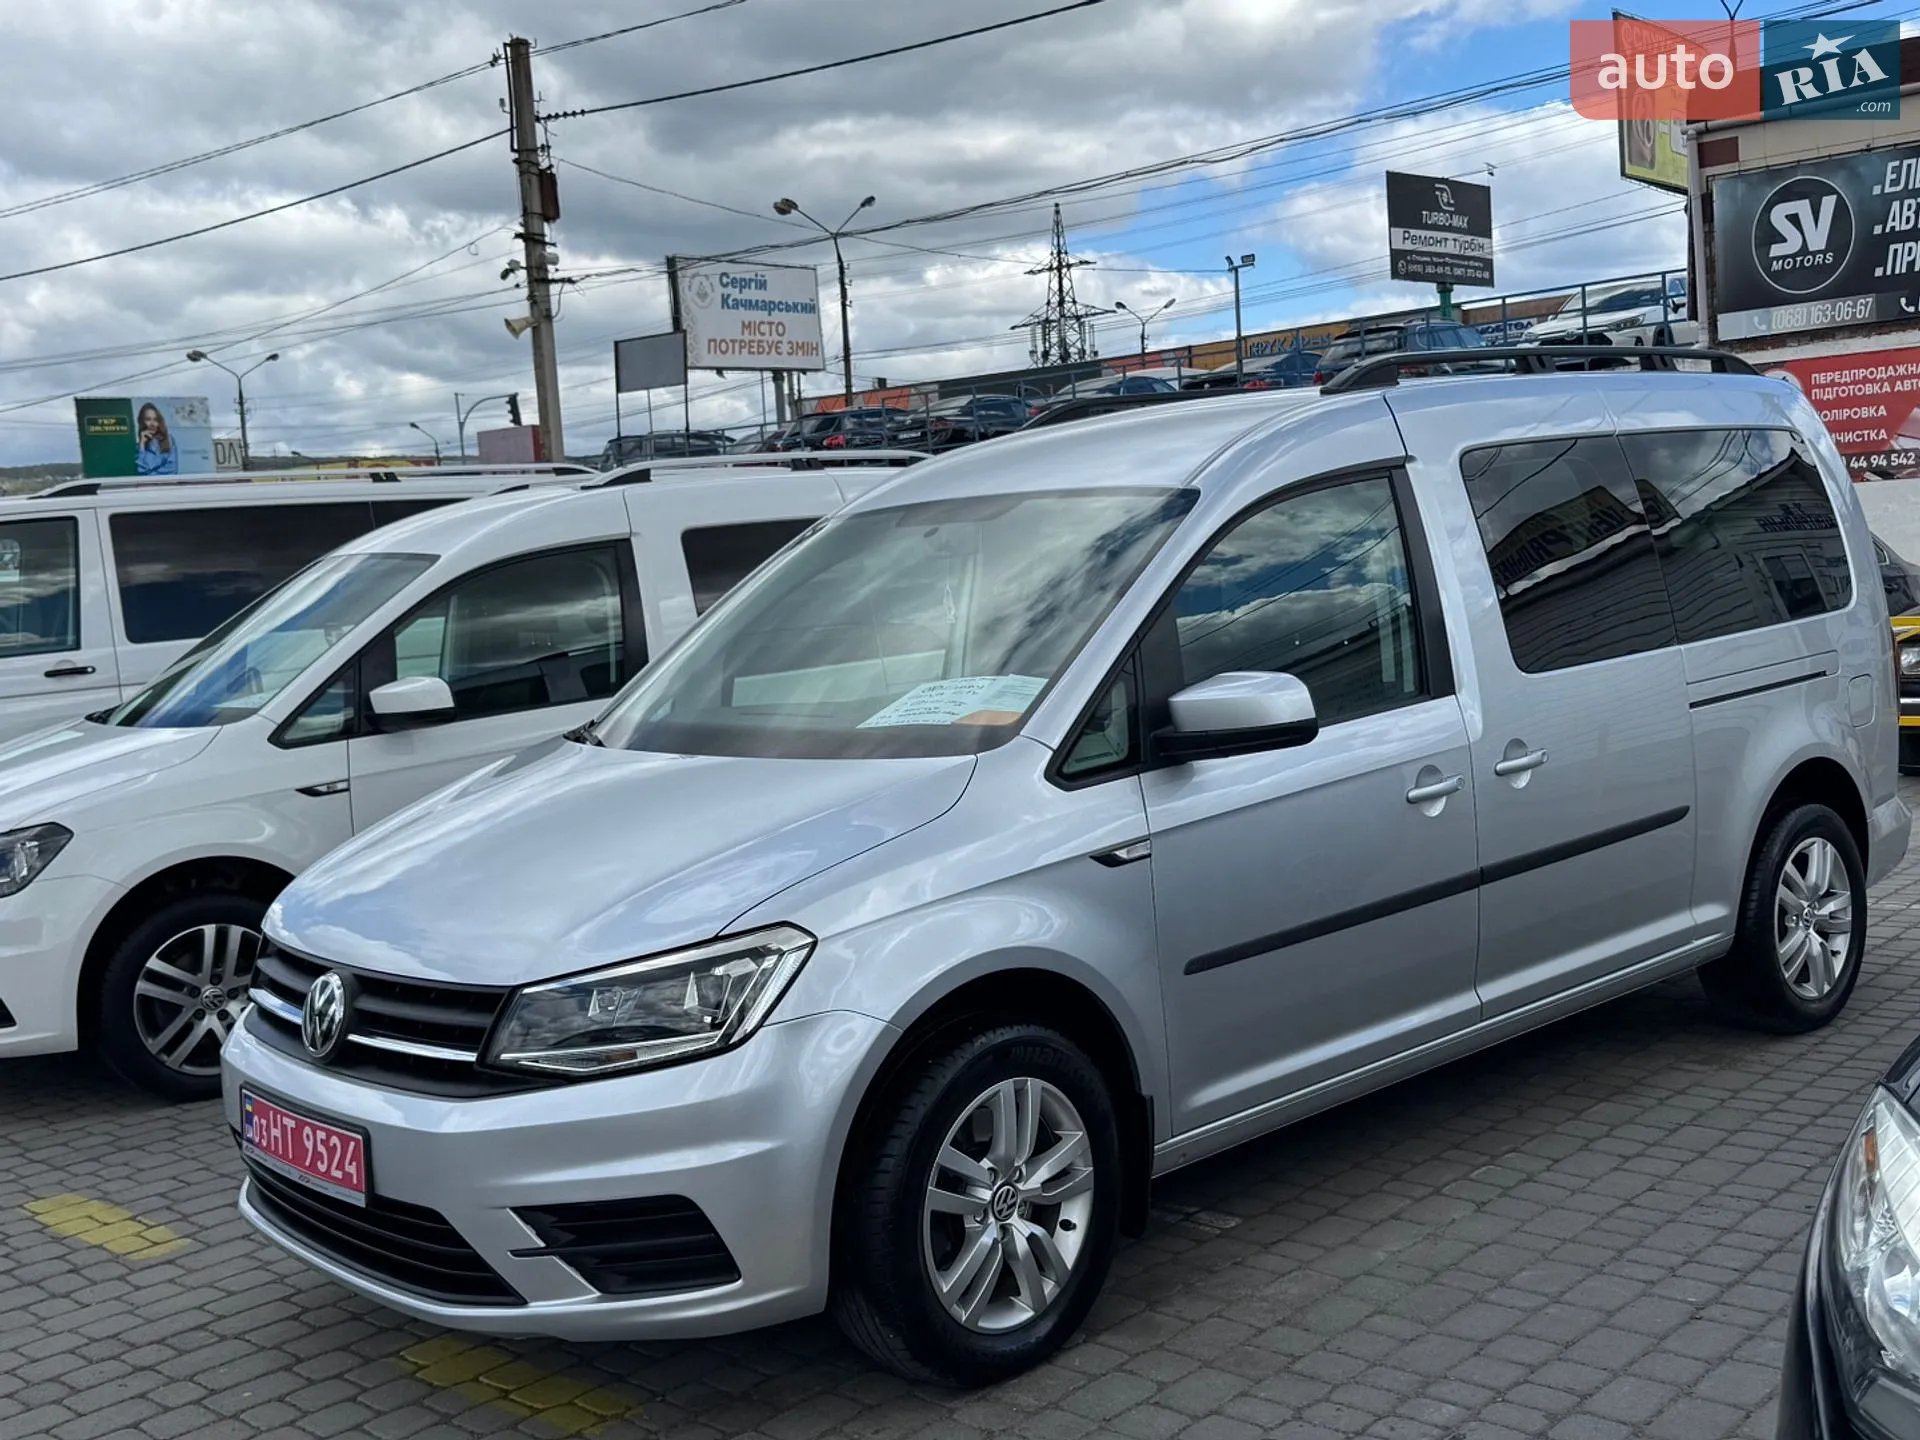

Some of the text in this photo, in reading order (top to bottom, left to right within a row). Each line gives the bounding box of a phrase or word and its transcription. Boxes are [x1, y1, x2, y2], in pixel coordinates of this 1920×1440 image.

[1768, 194, 1837, 258] SV
[1402, 230, 1448, 250] Ремонт
[1770, 251, 1835, 273] MOTORS
[719, 272, 768, 294] Сергій
[721, 293, 816, 316] Качмарський
[1771, 297, 1874, 330] (068) 163-06-67
[741, 320, 786, 337] МІСТО
[708, 339, 819, 357] ПОТРЕБУЄ ЗМІН
[1811, 379, 1920, 401] ПІДГОТОВКА АВТ
[1850, 452, 1916, 468] 44 94 542
[302, 1126, 358, 1185] 9524
